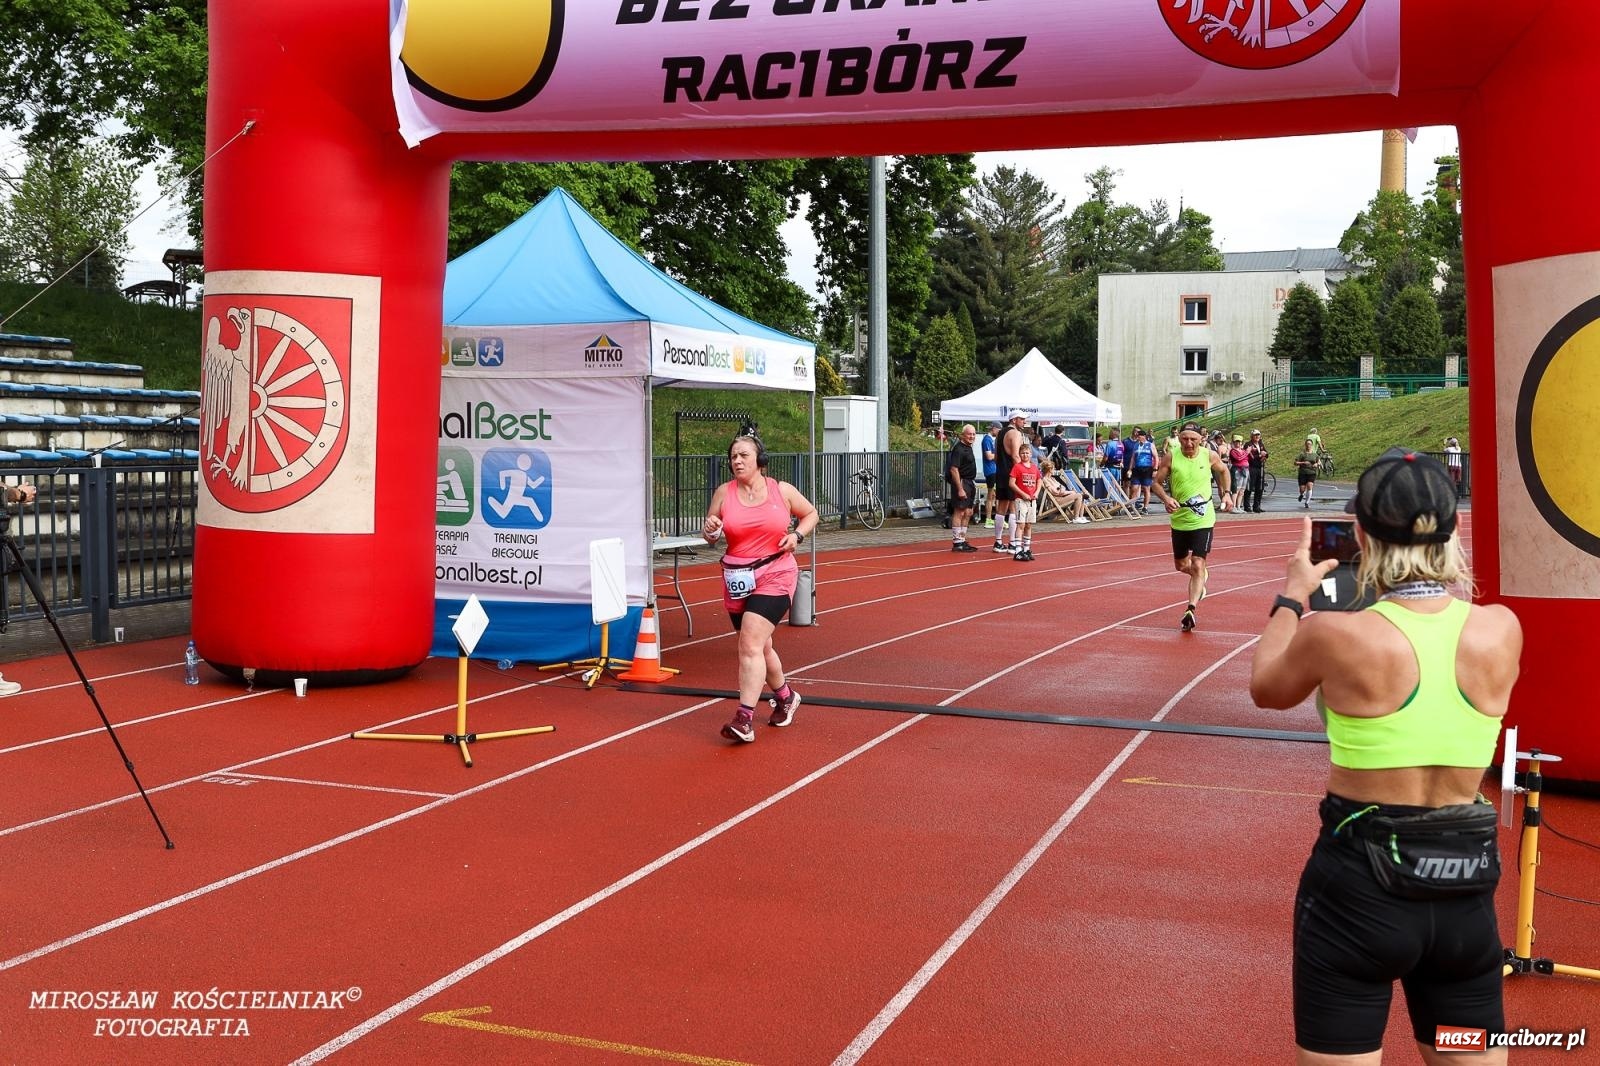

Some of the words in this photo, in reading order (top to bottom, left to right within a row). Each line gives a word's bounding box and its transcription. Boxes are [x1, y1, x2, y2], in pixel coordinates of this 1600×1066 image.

[661, 28, 1027, 103] RACIBÓRZ
[584, 348, 623, 362] MITKO
[663, 339, 731, 369] PersonalBest
[438, 401, 552, 440] alBest
[494, 533, 538, 545] TRENINGI
[492, 548, 539, 559] BIEGOWE
